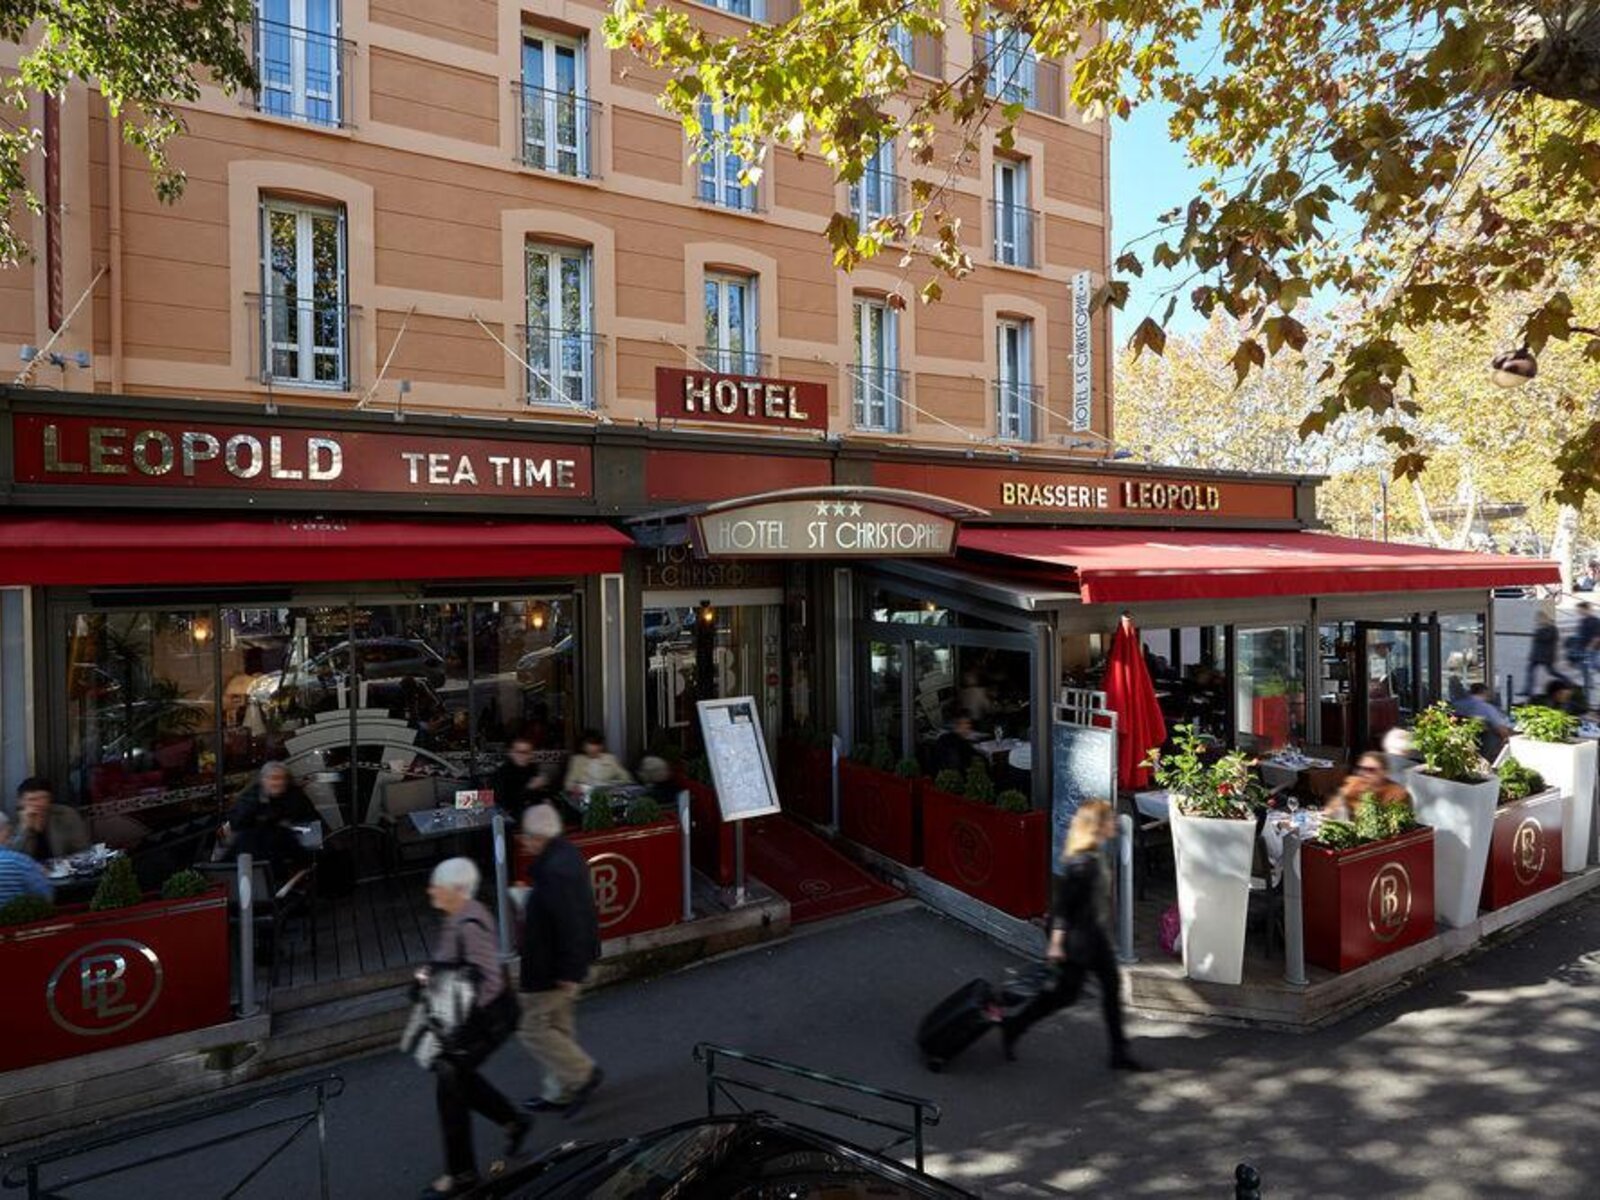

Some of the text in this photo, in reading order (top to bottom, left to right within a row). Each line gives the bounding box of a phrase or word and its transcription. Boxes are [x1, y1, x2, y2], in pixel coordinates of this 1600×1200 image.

[1076, 370, 1088, 384] ST
[685, 375, 808, 420] HOTEL
[1076, 387, 1088, 429] HOTEL
[42, 424, 343, 481] LEOPOLD
[402, 452, 575, 488] TEA TIME
[1002, 481, 1220, 511] BRASSERIE LEOPOLD
[718, 521, 943, 549] HOTEL ST CHRISTOPHE
